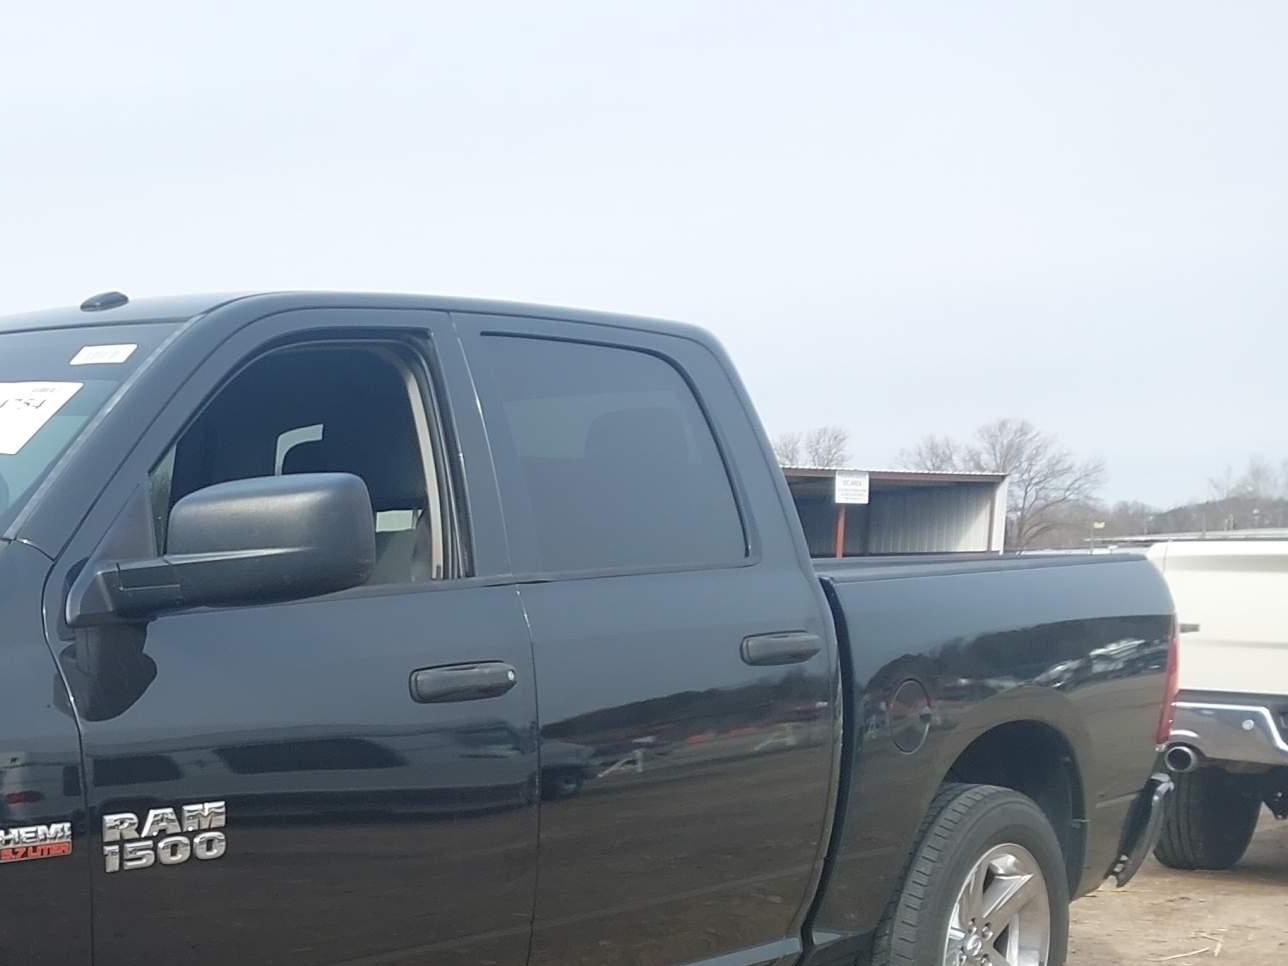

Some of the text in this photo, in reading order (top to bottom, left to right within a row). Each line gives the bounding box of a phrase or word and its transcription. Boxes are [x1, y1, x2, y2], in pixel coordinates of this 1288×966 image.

[102, 800, 226, 842] RAM
[27, 841, 71, 859] LITER
[103, 831, 227, 873] 1500
